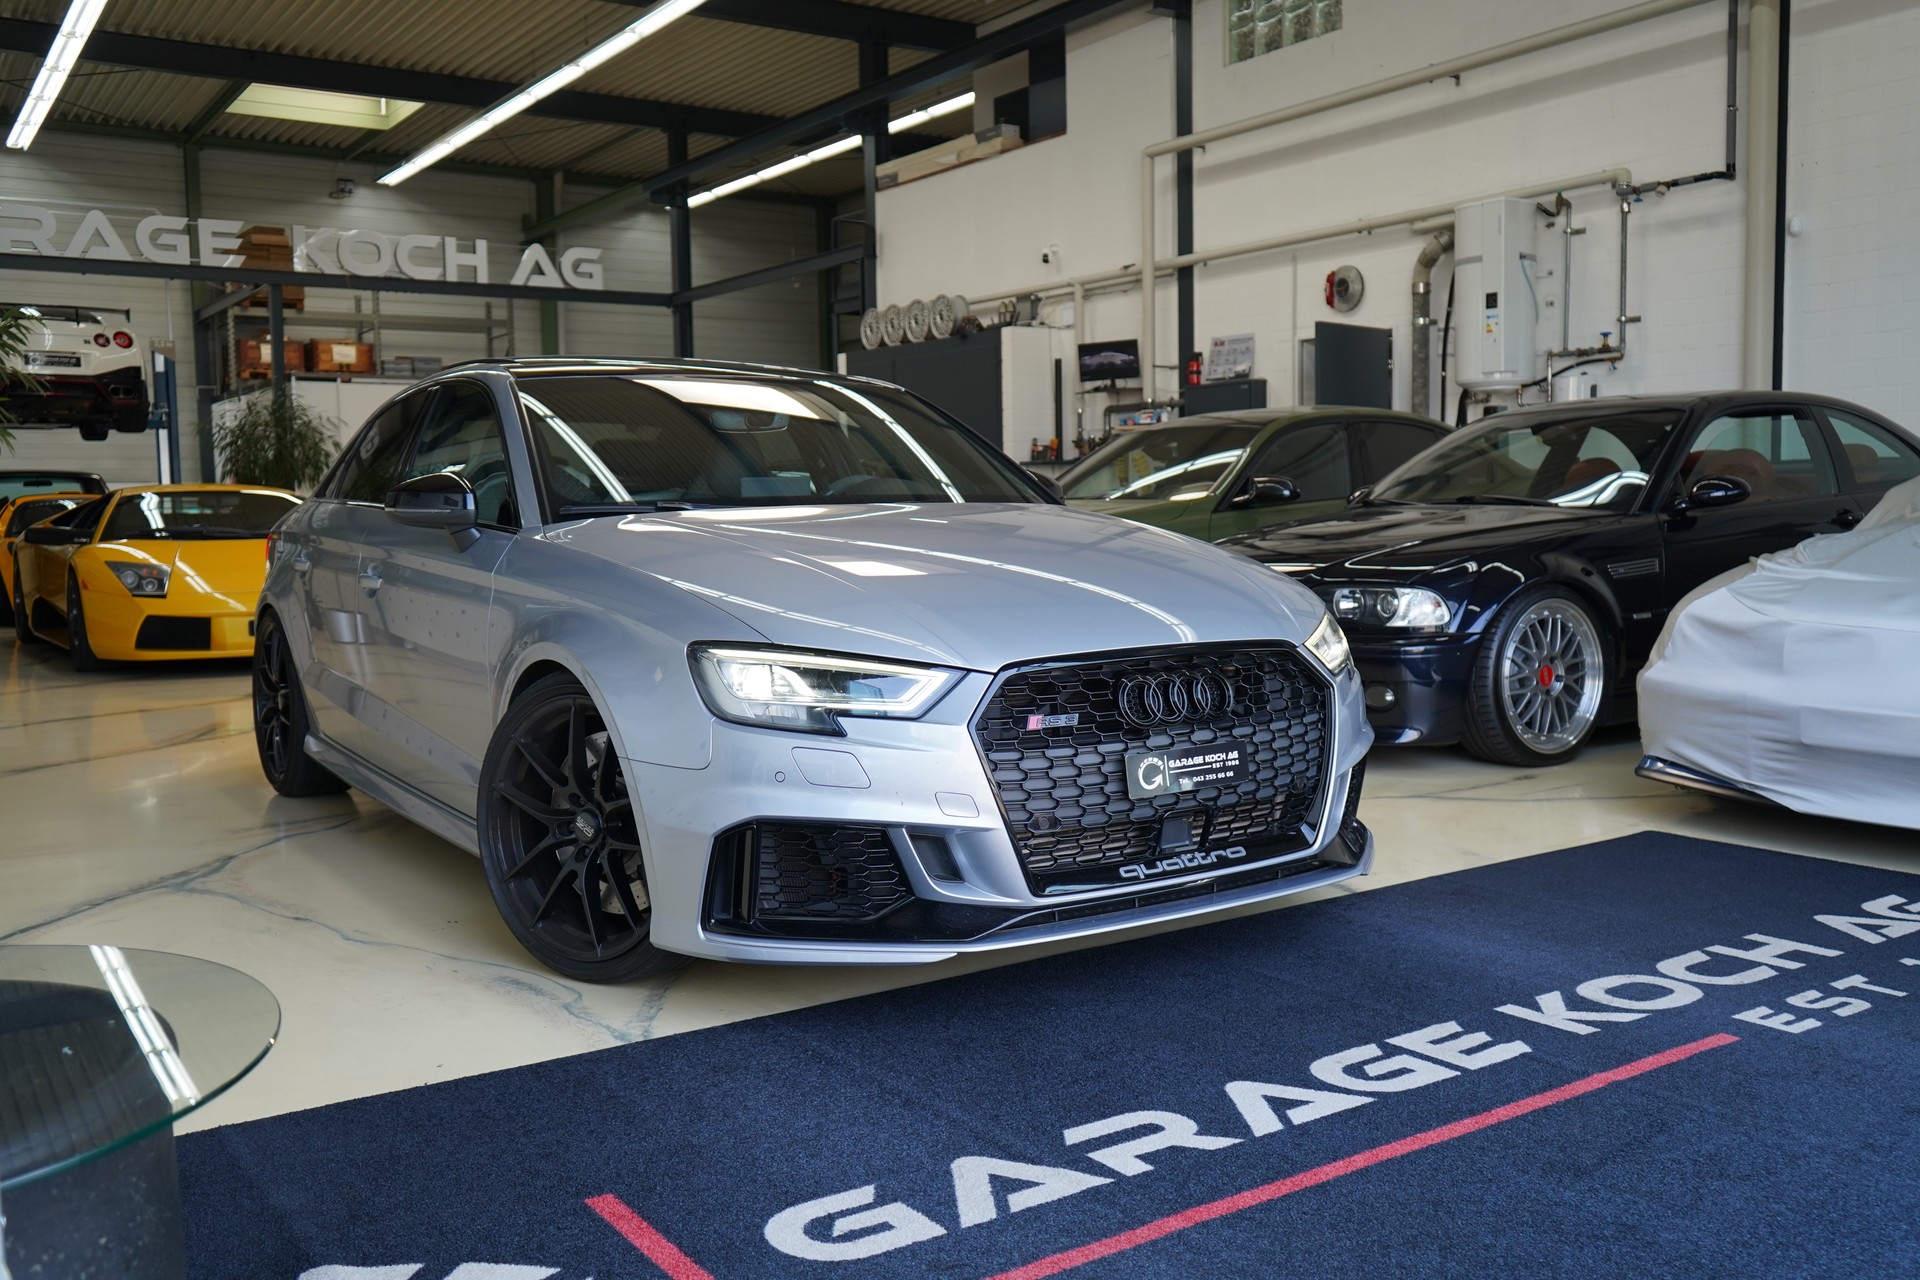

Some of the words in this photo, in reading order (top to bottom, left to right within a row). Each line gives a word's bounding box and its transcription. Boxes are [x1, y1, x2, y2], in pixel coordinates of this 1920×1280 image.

[292, 225, 488, 283] KOCH
[509, 243, 603, 290] AG
[1168, 755, 1204, 768] GARAGE
[1205, 752, 1227, 763] KOCH
[1227, 750, 1239, 760] AG
[1212, 761, 1224, 769] EST
[1225, 759, 1240, 767] 1986
[1179, 777, 1191, 785] Tel.
[1192, 775, 1205, 783] 043
[1205, 773, 1217, 781] 255
[1217, 771, 1226, 779] 66
[1226, 770, 1234, 778] 66
[1119, 846, 1247, 879] quattro
[1731, 973, 1909, 1034] EST
[764, 1021, 1532, 1262] GARAGE
[1494, 932, 1845, 1034] KOCH
